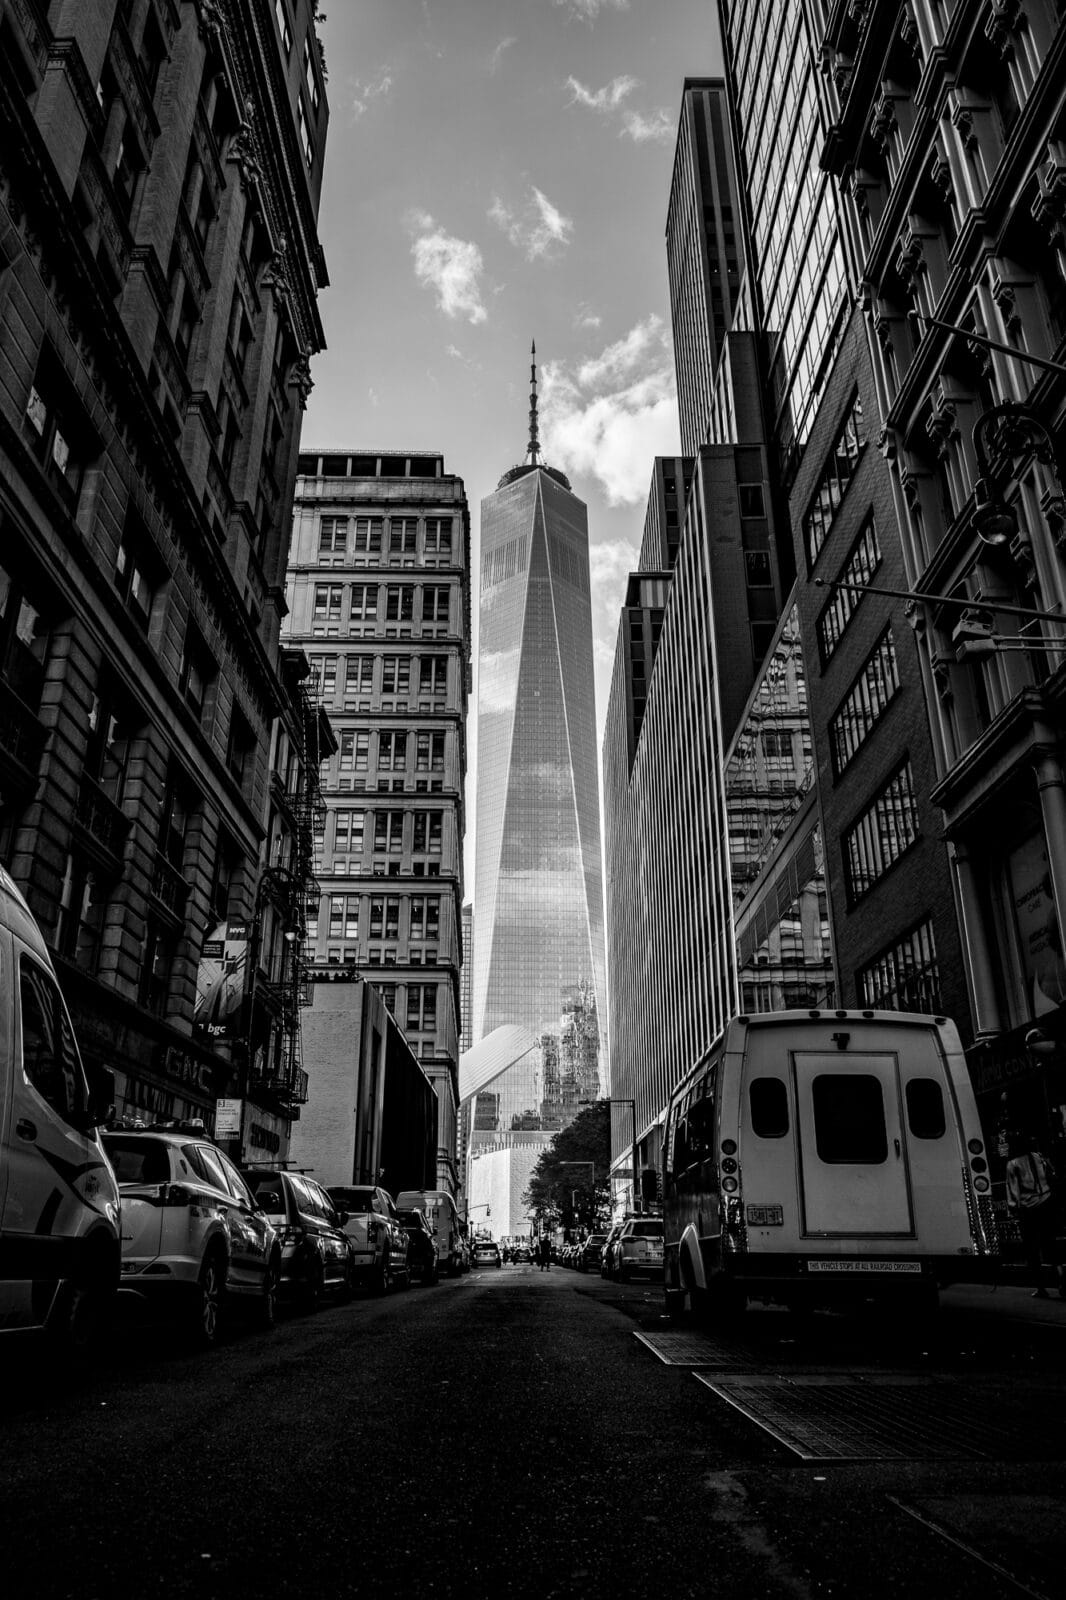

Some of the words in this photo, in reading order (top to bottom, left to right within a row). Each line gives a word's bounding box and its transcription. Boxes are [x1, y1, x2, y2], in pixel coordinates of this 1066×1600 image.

[208, 1022, 227, 1037] bgc
[166, 1045, 213, 1094] GNC
[809, 1262, 819, 1270] THIS
[821, 1262, 838, 1270] VEHICLE
[839, 1262, 854, 1270] STOPS
[870, 1263, 892, 1271] RAILROAD
[893, 1263, 920, 1271] CROSSINGS
